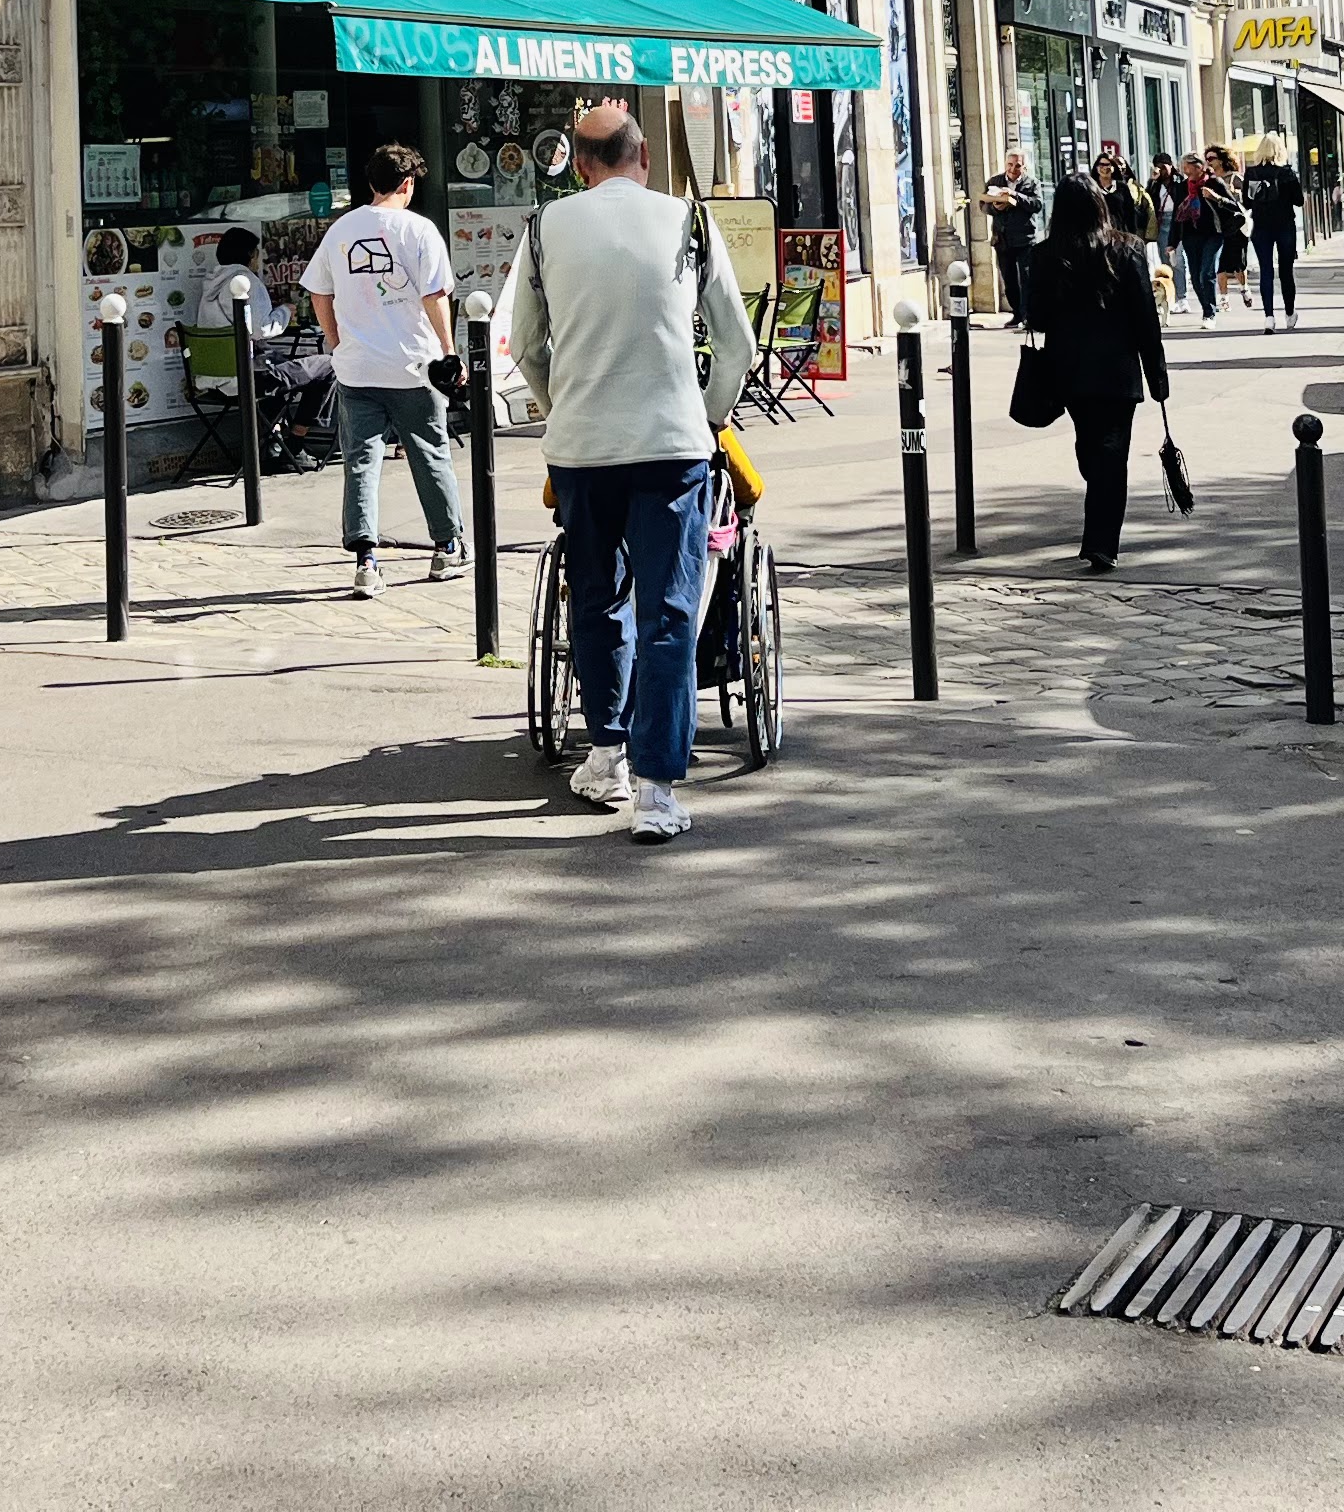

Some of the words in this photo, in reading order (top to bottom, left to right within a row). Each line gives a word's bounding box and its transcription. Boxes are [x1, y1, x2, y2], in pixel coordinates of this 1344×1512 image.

[1232, 15, 1317, 52] MFA
[475, 35, 635, 81] ALIMENTS
[670, 46, 794, 86] EXPRESS
